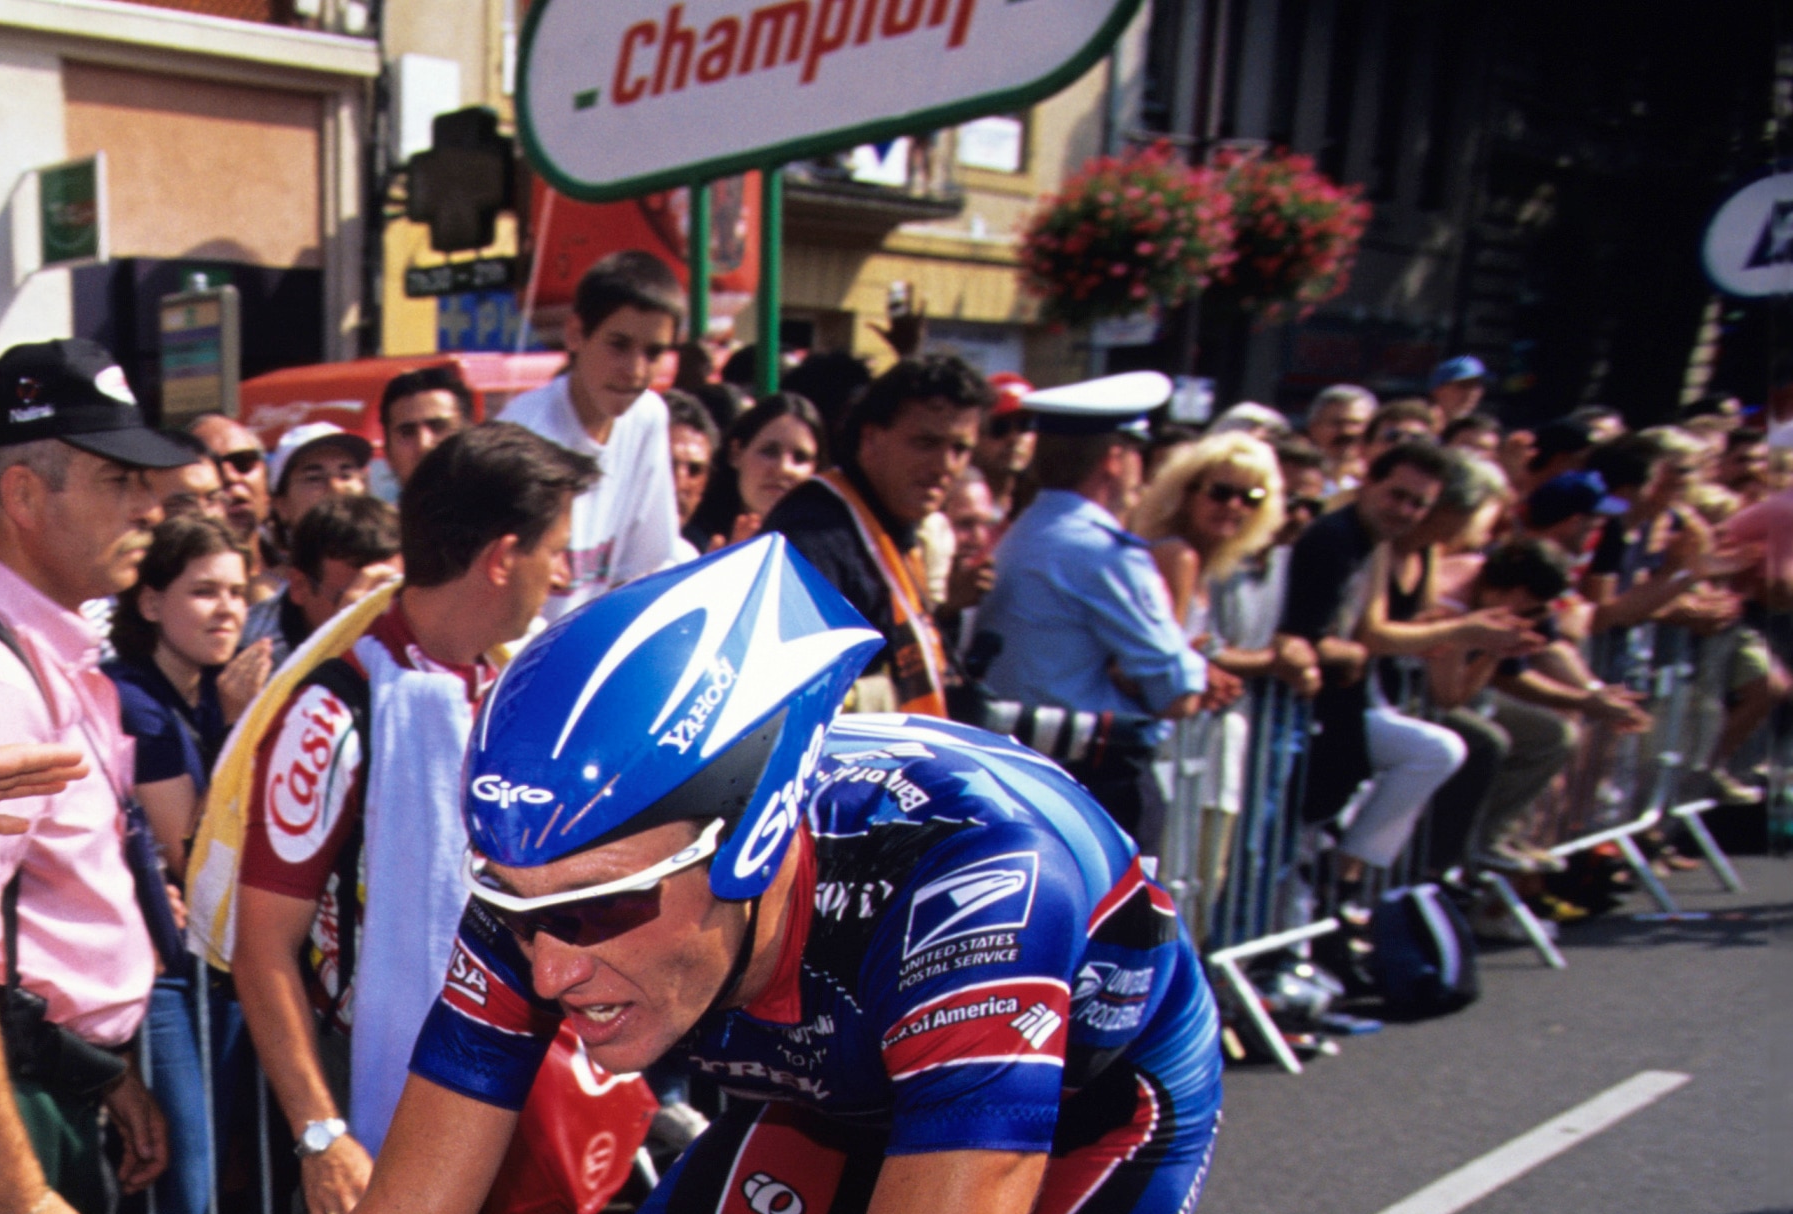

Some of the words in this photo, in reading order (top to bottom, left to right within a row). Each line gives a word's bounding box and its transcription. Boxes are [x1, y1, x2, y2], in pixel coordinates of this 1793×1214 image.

[658, 656, 739, 756] YAHOO!
[471, 775, 554, 809] Giro
[898, 943, 957, 977] UNITED
[958, 932, 1016, 954] STATES
[898, 962, 950, 992] POSTAL
[953, 948, 1019, 970] SERVICE
[932, 996, 1019, 1029] America
